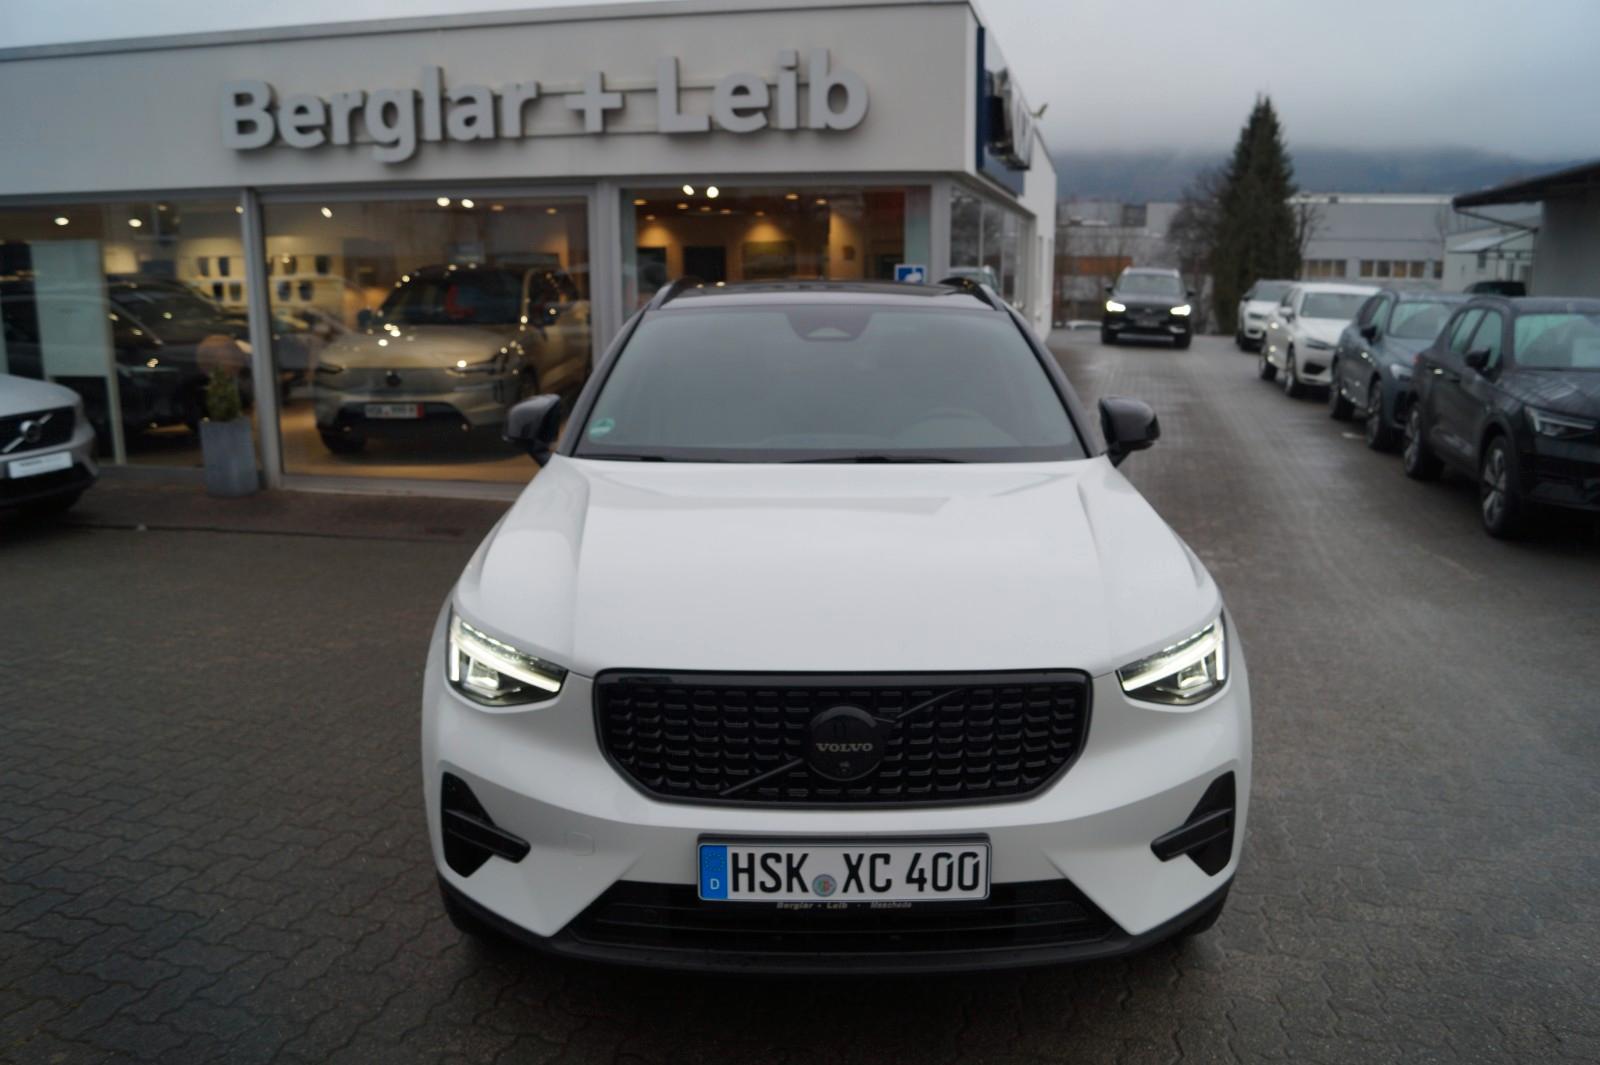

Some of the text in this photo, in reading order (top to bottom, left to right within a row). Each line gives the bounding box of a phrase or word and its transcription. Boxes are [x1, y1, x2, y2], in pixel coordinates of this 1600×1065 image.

[222, 48, 869, 163] Berglar + Leib
[816, 742, 873, 752] VOLVO
[710, 851, 980, 893] D HSK XC 400
